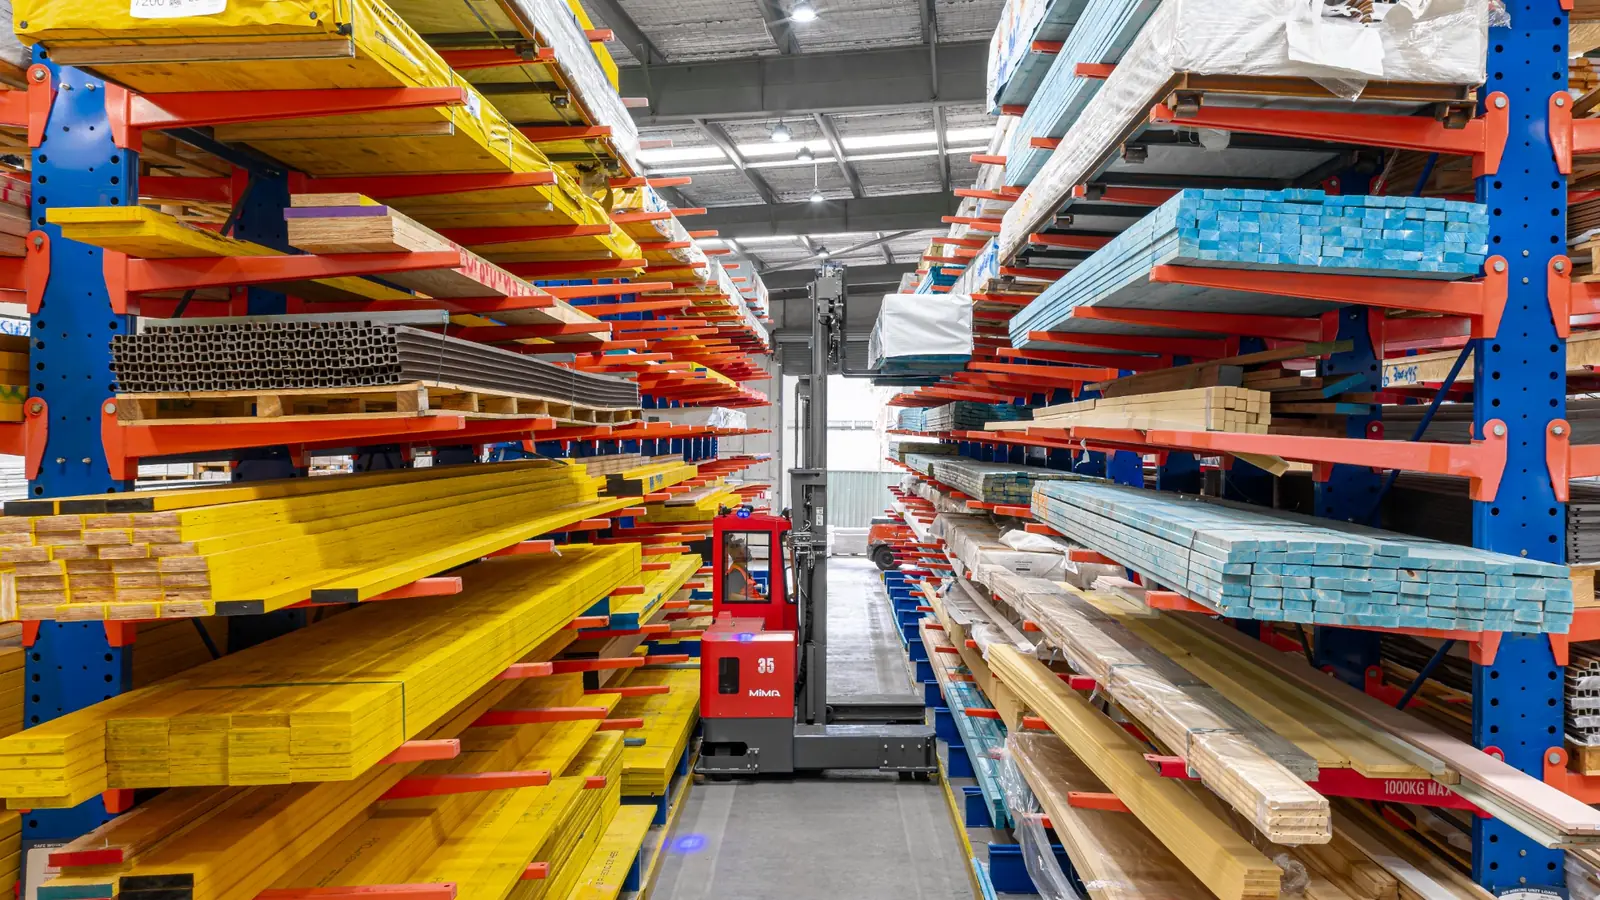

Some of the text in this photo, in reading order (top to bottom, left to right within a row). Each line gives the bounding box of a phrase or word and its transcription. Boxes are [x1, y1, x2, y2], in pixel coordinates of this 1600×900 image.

[757, 657, 774, 673] 35
[1384, 780, 1452, 796] 1000KG MAX
